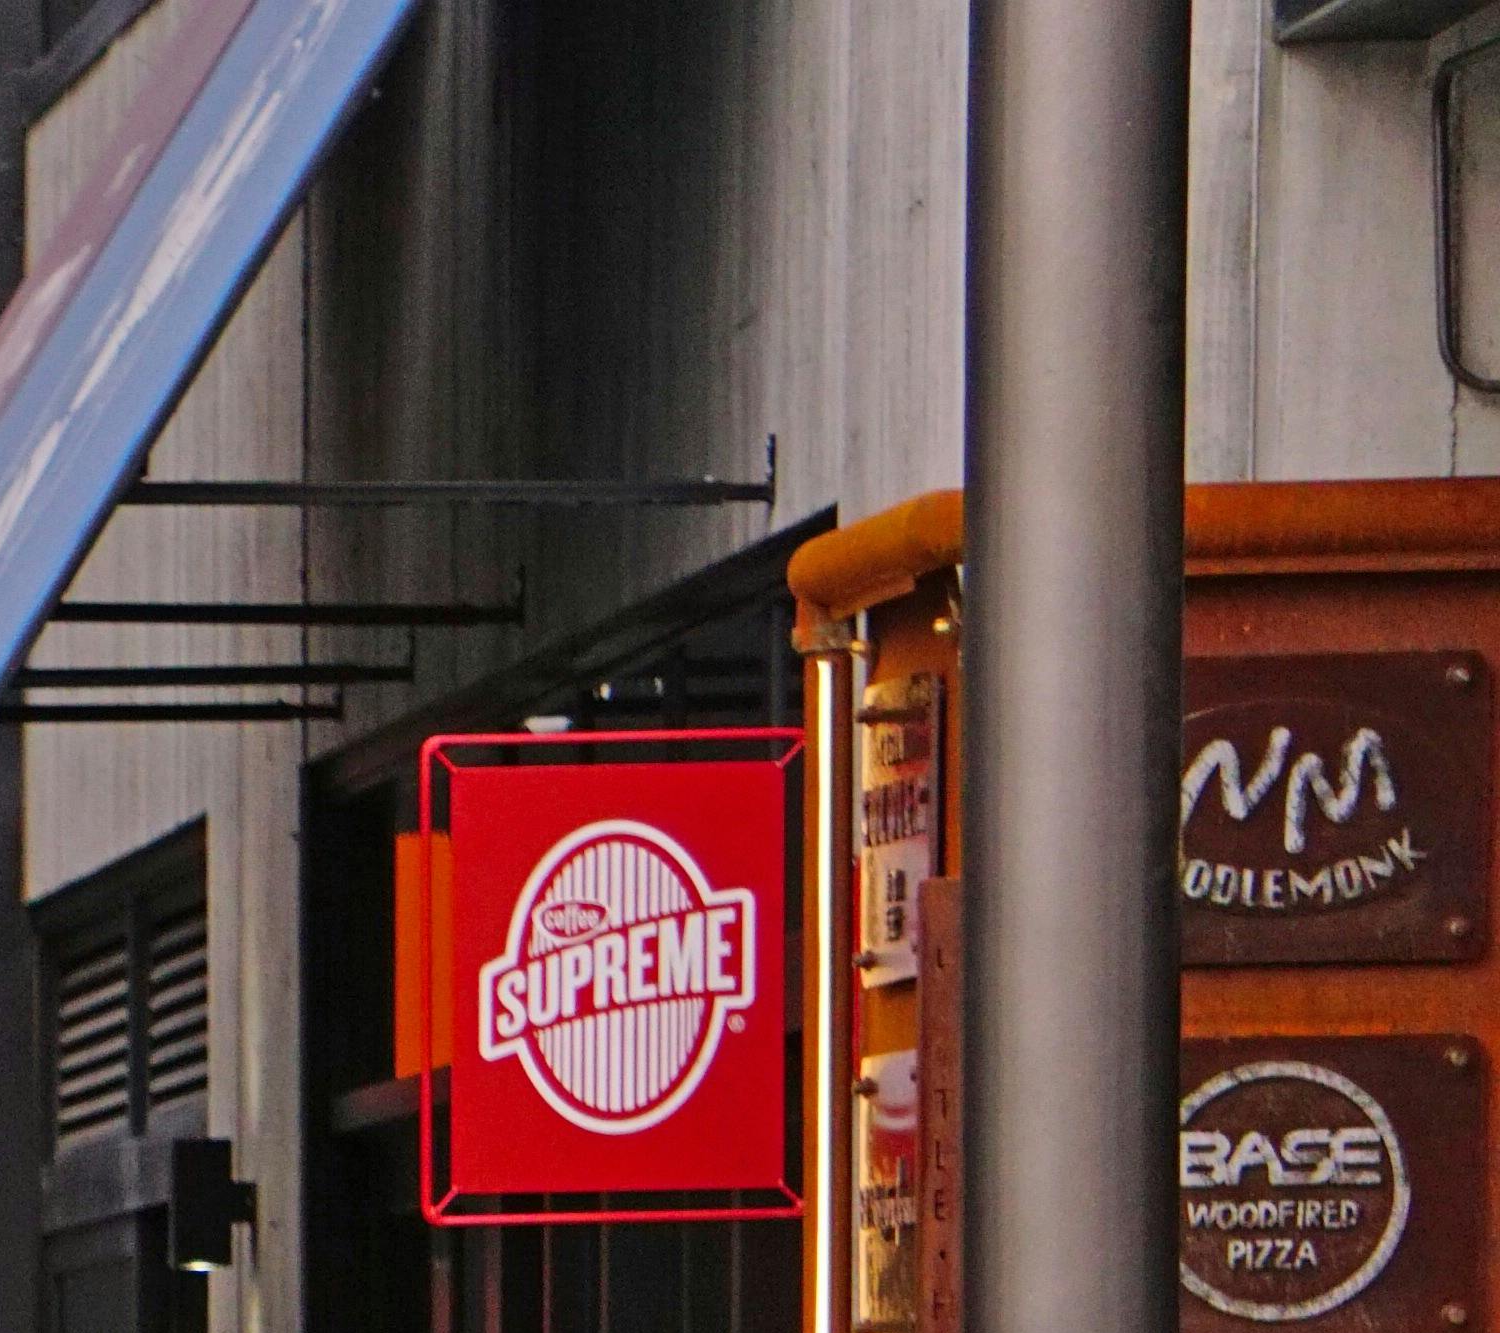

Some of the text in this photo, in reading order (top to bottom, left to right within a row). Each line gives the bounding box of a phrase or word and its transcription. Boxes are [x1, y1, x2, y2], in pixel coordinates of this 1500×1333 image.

[1183, 827, 1427, 908] ODLEMONK
[497, 907, 737, 1038] SUPREME
[1180, 1128, 1382, 1187] BASE
[1186, 1199, 1359, 1231] WOODFIRED
[1227, 1239, 1318, 1270] PIZZA
